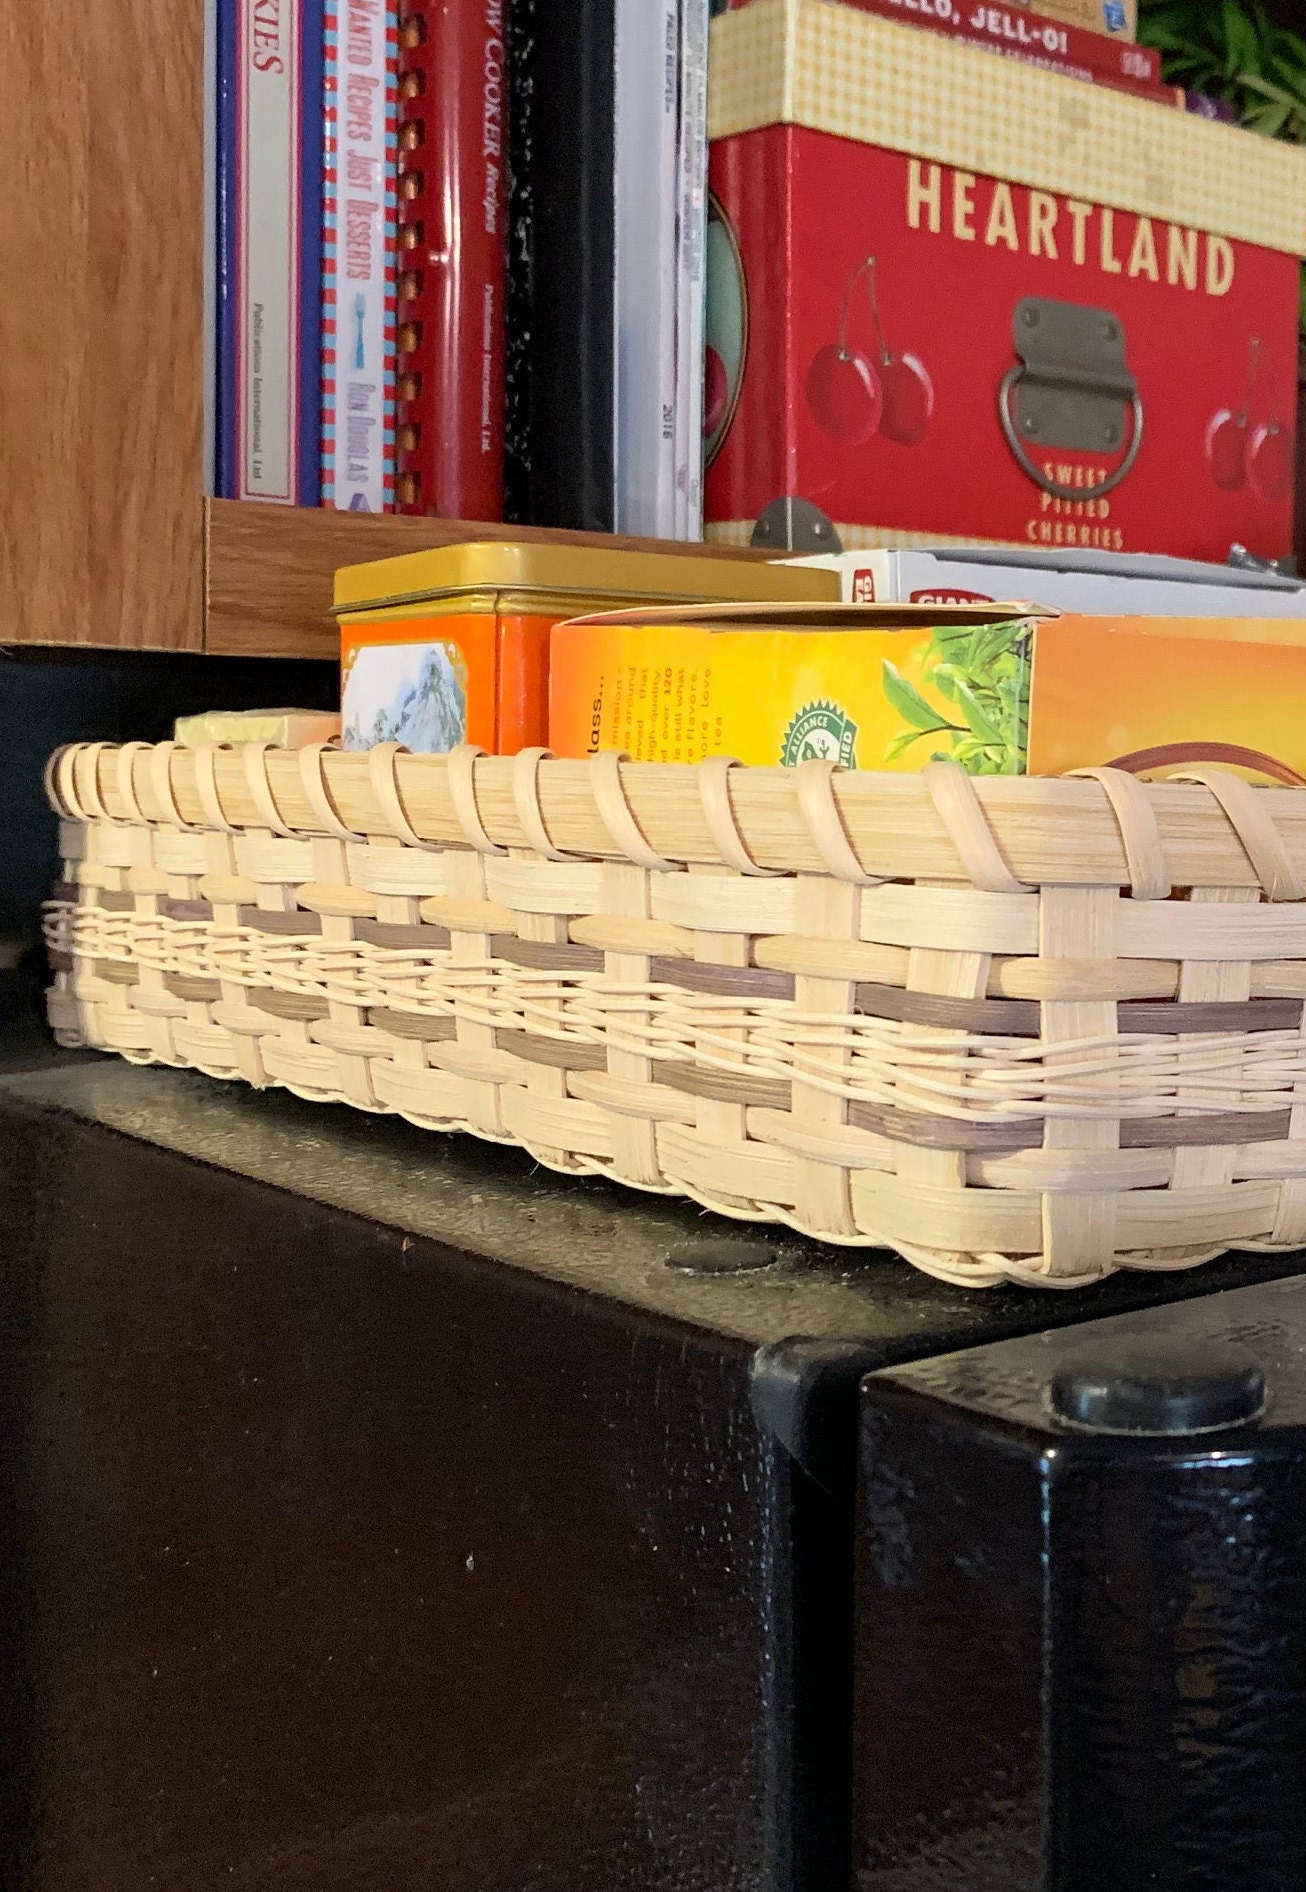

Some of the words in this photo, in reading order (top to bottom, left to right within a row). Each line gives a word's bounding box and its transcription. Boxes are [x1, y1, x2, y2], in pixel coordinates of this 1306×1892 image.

[347, 73, 380, 142] RECIPES
[484, 38, 504, 156] COOKER
[347, 149, 378, 192] JUST
[346, 199, 379, 280] DESSERTS
[907, 159, 1235, 296] HEARTLAND
[347, 416, 376, 483] DOUGLAS
[1043, 461, 1107, 489] SWEET
[1027, 520, 1123, 549] CHERRIES
[625, 667, 636, 725] around
[639, 667, 649, 700] that
[664, 667, 672, 696] 120
[676, 667, 685, 707] what
[701, 668, 711, 707] love
[661, 704, 669, 740] over
[674, 713, 682, 742] still
[714, 716, 722, 746] tea
[790, 715, 829, 756] ALLIANCE
